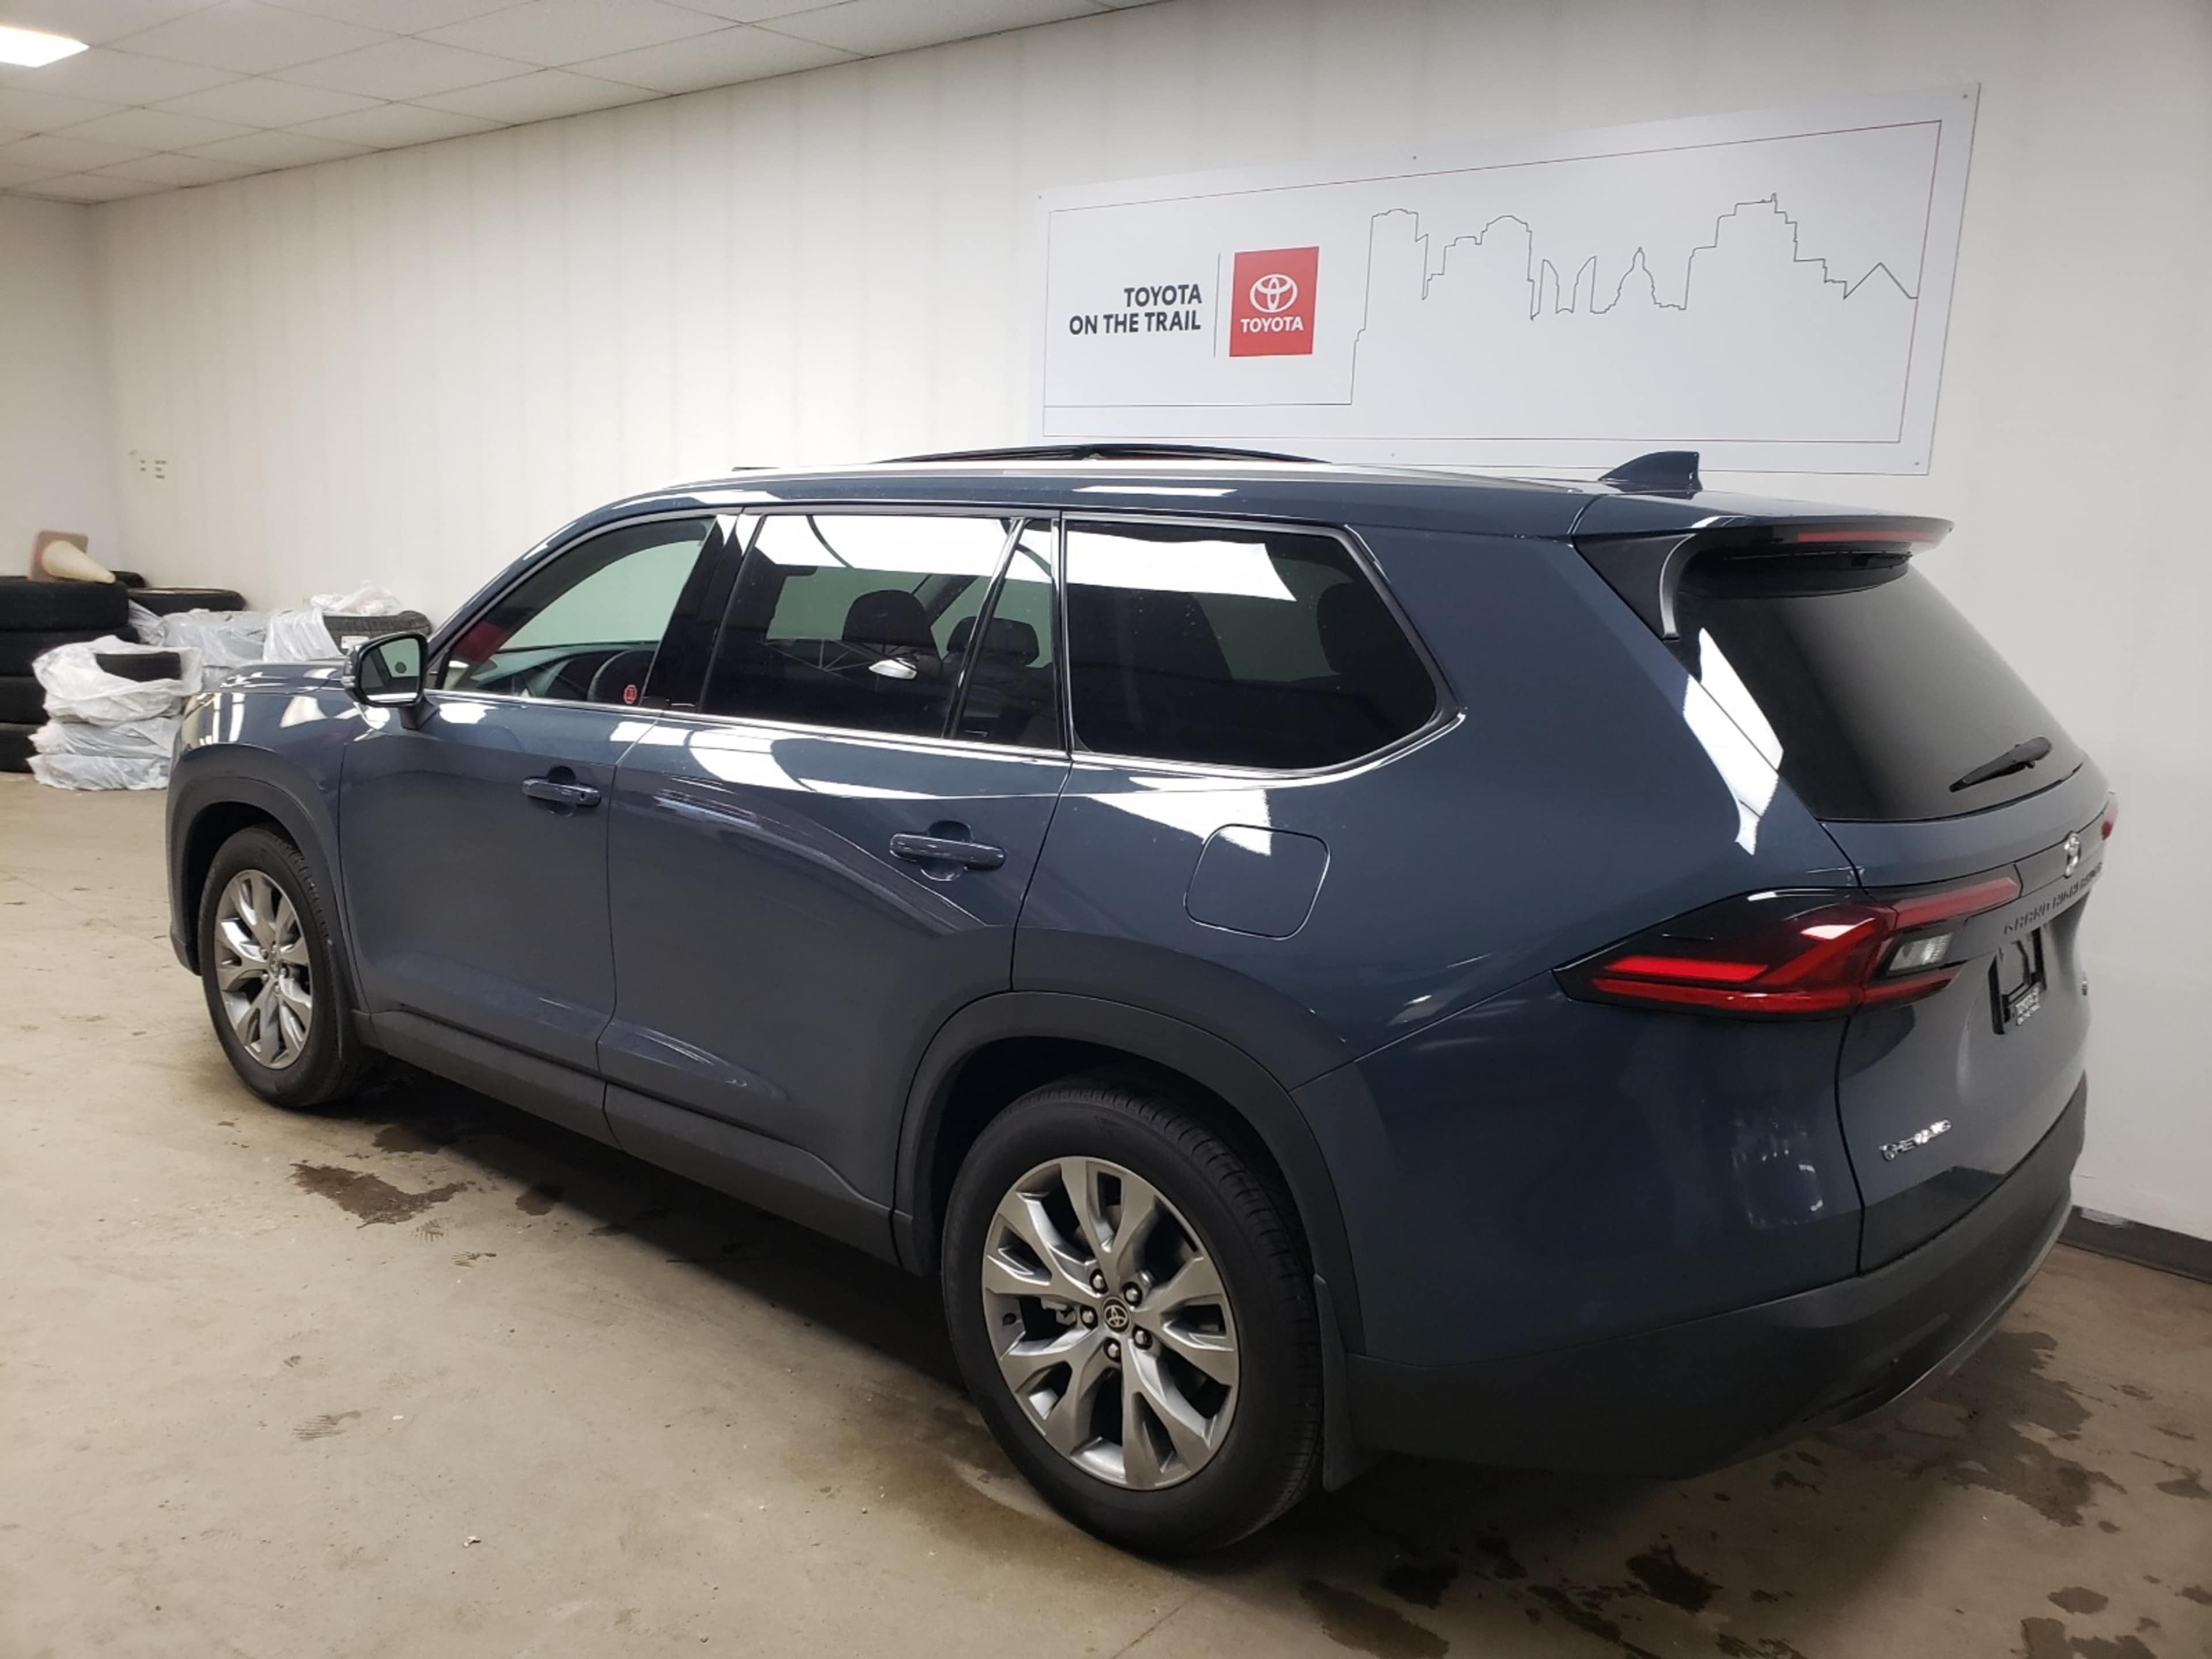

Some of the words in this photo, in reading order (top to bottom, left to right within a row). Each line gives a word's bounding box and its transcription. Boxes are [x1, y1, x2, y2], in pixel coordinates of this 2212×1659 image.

[1124, 284, 1202, 308] TOYOTA
[1069, 315, 1098, 335] ON
[1103, 313, 1139, 334] THE
[1145, 310, 1201, 332] TRAIL
[1240, 316, 1304, 333] TOYOTA
